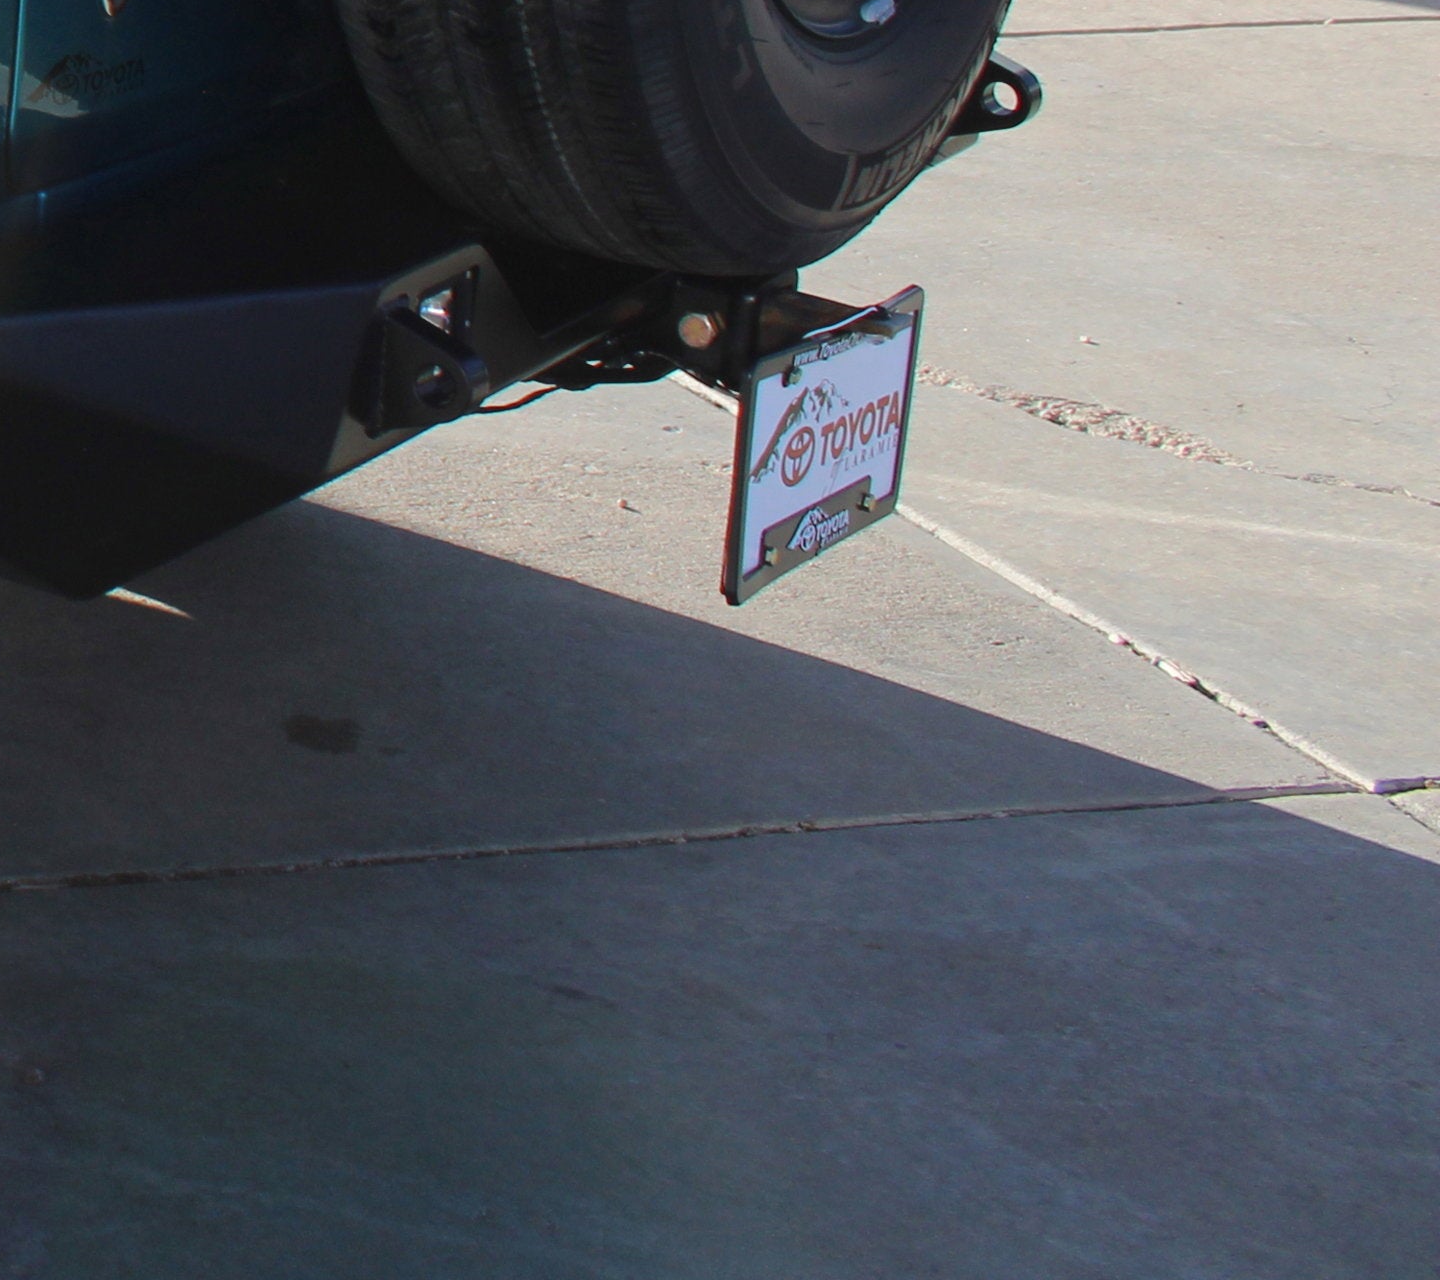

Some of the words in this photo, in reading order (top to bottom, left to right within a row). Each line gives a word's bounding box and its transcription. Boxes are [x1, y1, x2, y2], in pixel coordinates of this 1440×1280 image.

[820, 391, 900, 466] TOYOTA
[844, 433, 899, 471] LARAMIE
[817, 509, 850, 540] TOYOTA
